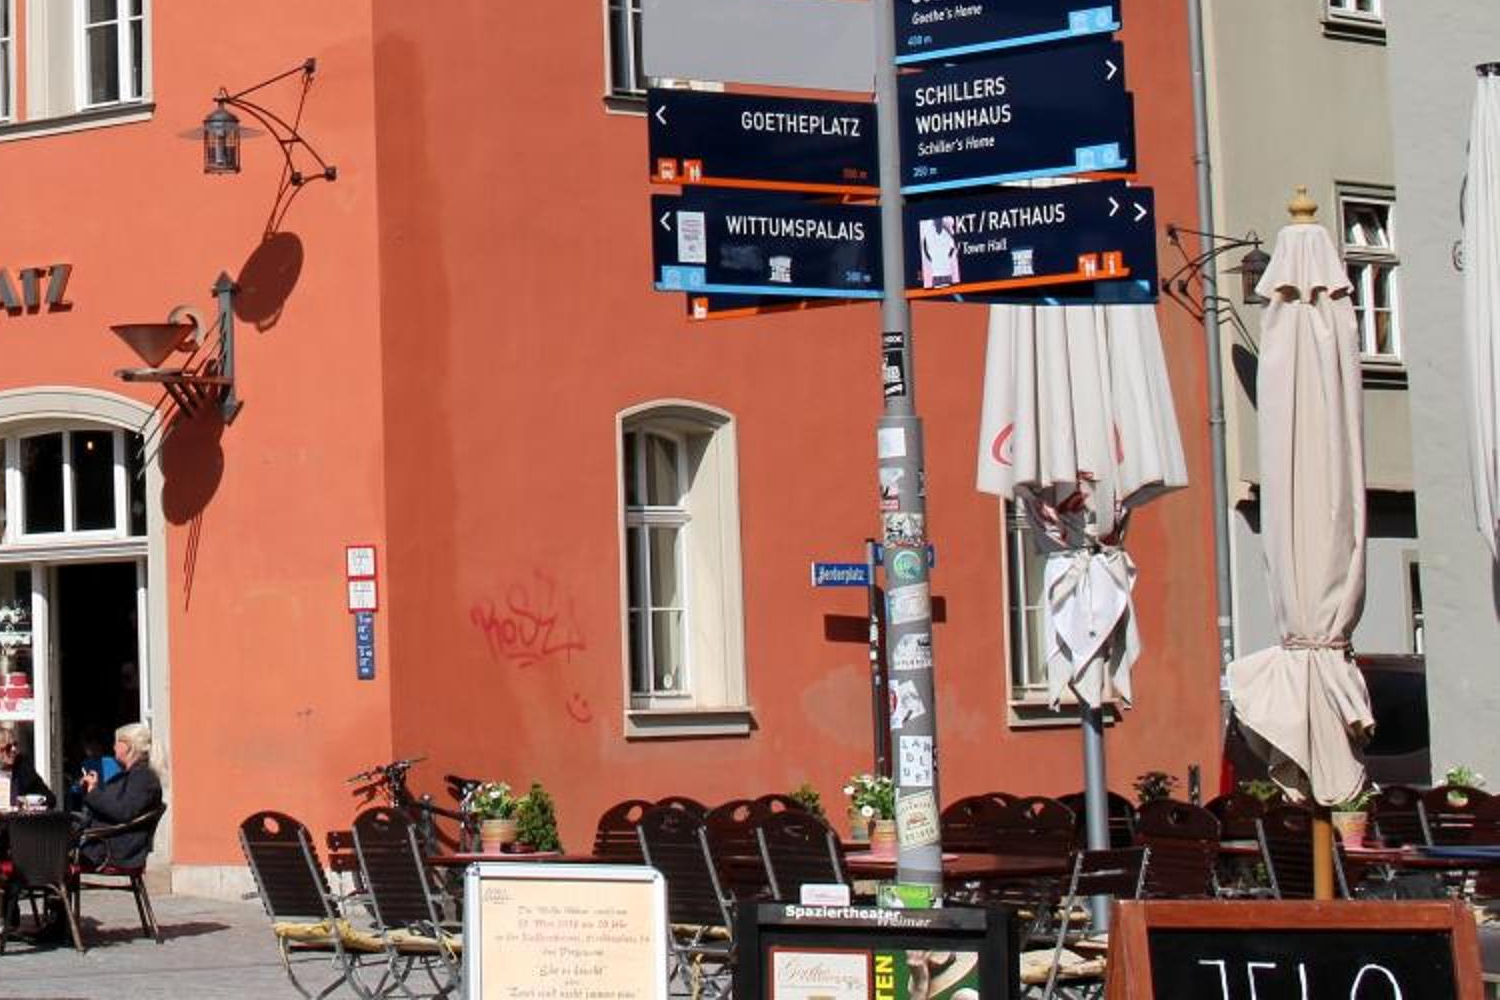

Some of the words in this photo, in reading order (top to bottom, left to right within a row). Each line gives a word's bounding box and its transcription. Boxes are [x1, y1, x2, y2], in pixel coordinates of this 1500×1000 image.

[912, 7, 953, 25] Goethe's
[954, 4, 983, 18] Home
[915, 77, 1006, 107] SCHILLERS
[741, 111, 861, 137] GOETHEPLATZ
[915, 104, 1012, 135] WOHNHAUS
[917, 138, 963, 157] Schiller's
[965, 136, 995, 150] Home
[726, 215, 865, 241] WITTUMSPALAIS
[989, 204, 1066, 230] RATHAUS
[987, 238, 1008, 252] Hall
[784, 903, 902, 921] Spaziertheater
